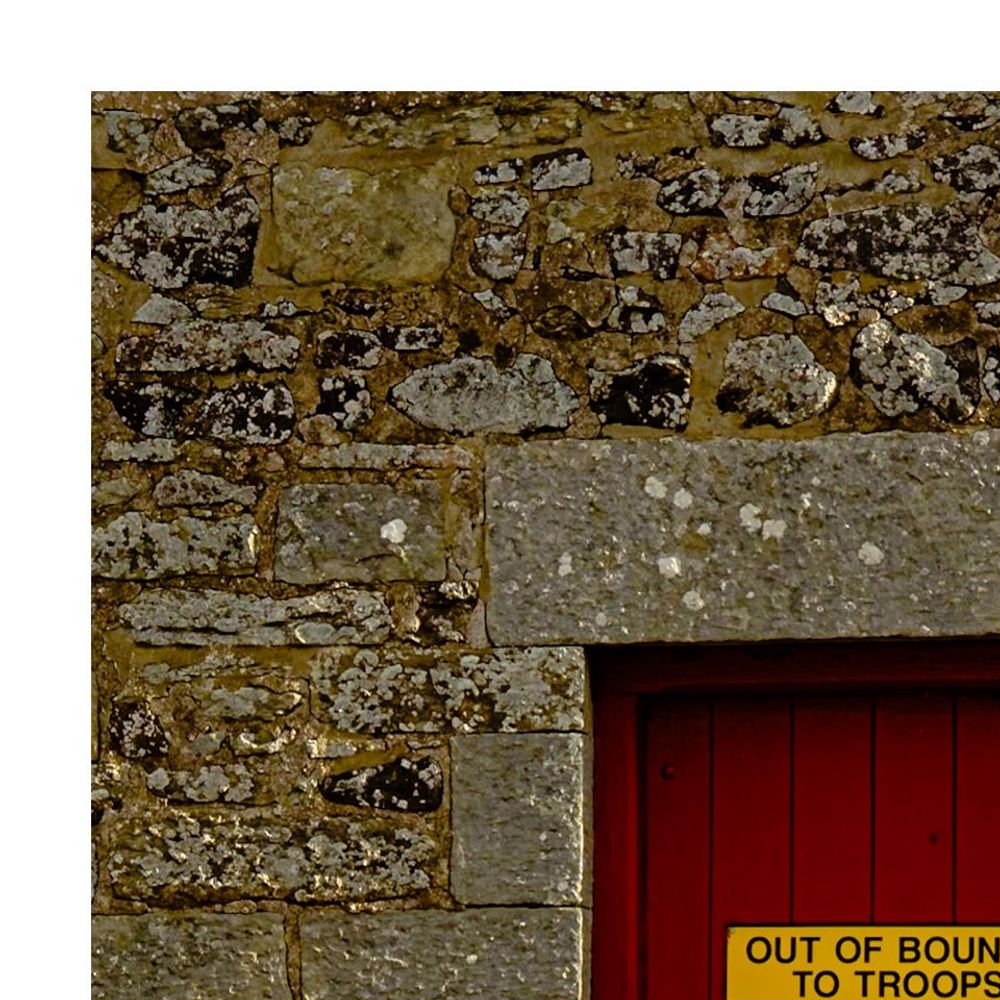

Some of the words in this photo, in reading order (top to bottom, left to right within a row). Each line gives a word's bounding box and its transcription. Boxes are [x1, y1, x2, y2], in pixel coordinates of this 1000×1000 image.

[745, 936, 821, 965] OUT
[836, 935, 882, 965] OF
[792, 970, 839, 998] TO
